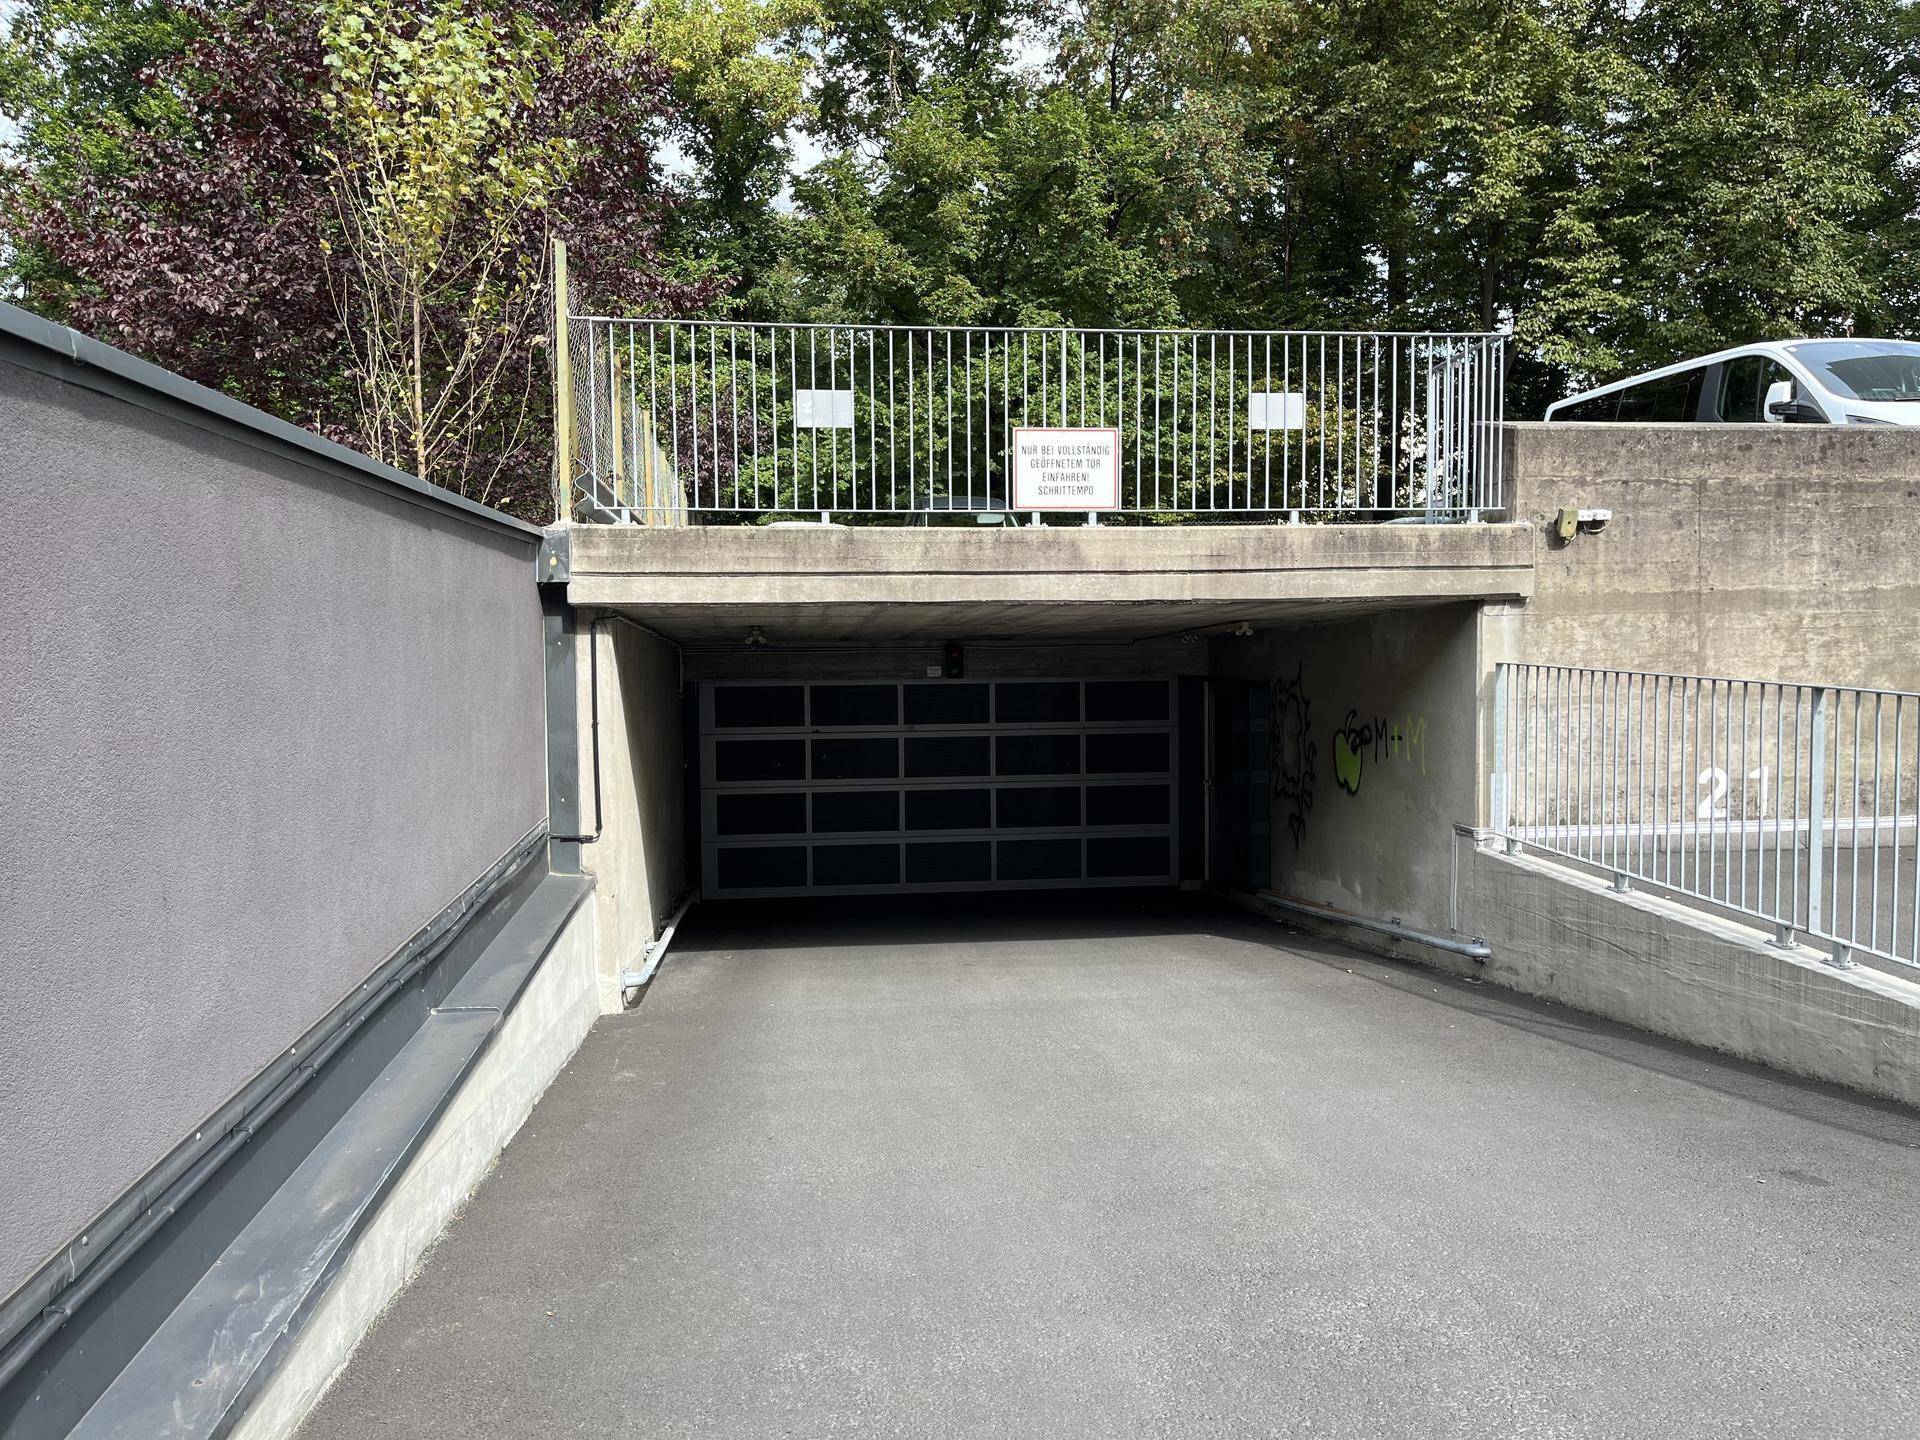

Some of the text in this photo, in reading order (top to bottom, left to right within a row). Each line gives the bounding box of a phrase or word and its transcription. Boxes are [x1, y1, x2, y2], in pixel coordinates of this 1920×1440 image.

[1021, 443, 1110, 455] NUR BEI VOLLSTÄNDIG
[1030, 457, 1101, 469] GEÖFFNETEM TOR
[1042, 472, 1090, 482] EINFAHREN!
[1038, 485, 1094, 495] SCHRITTEMPO
